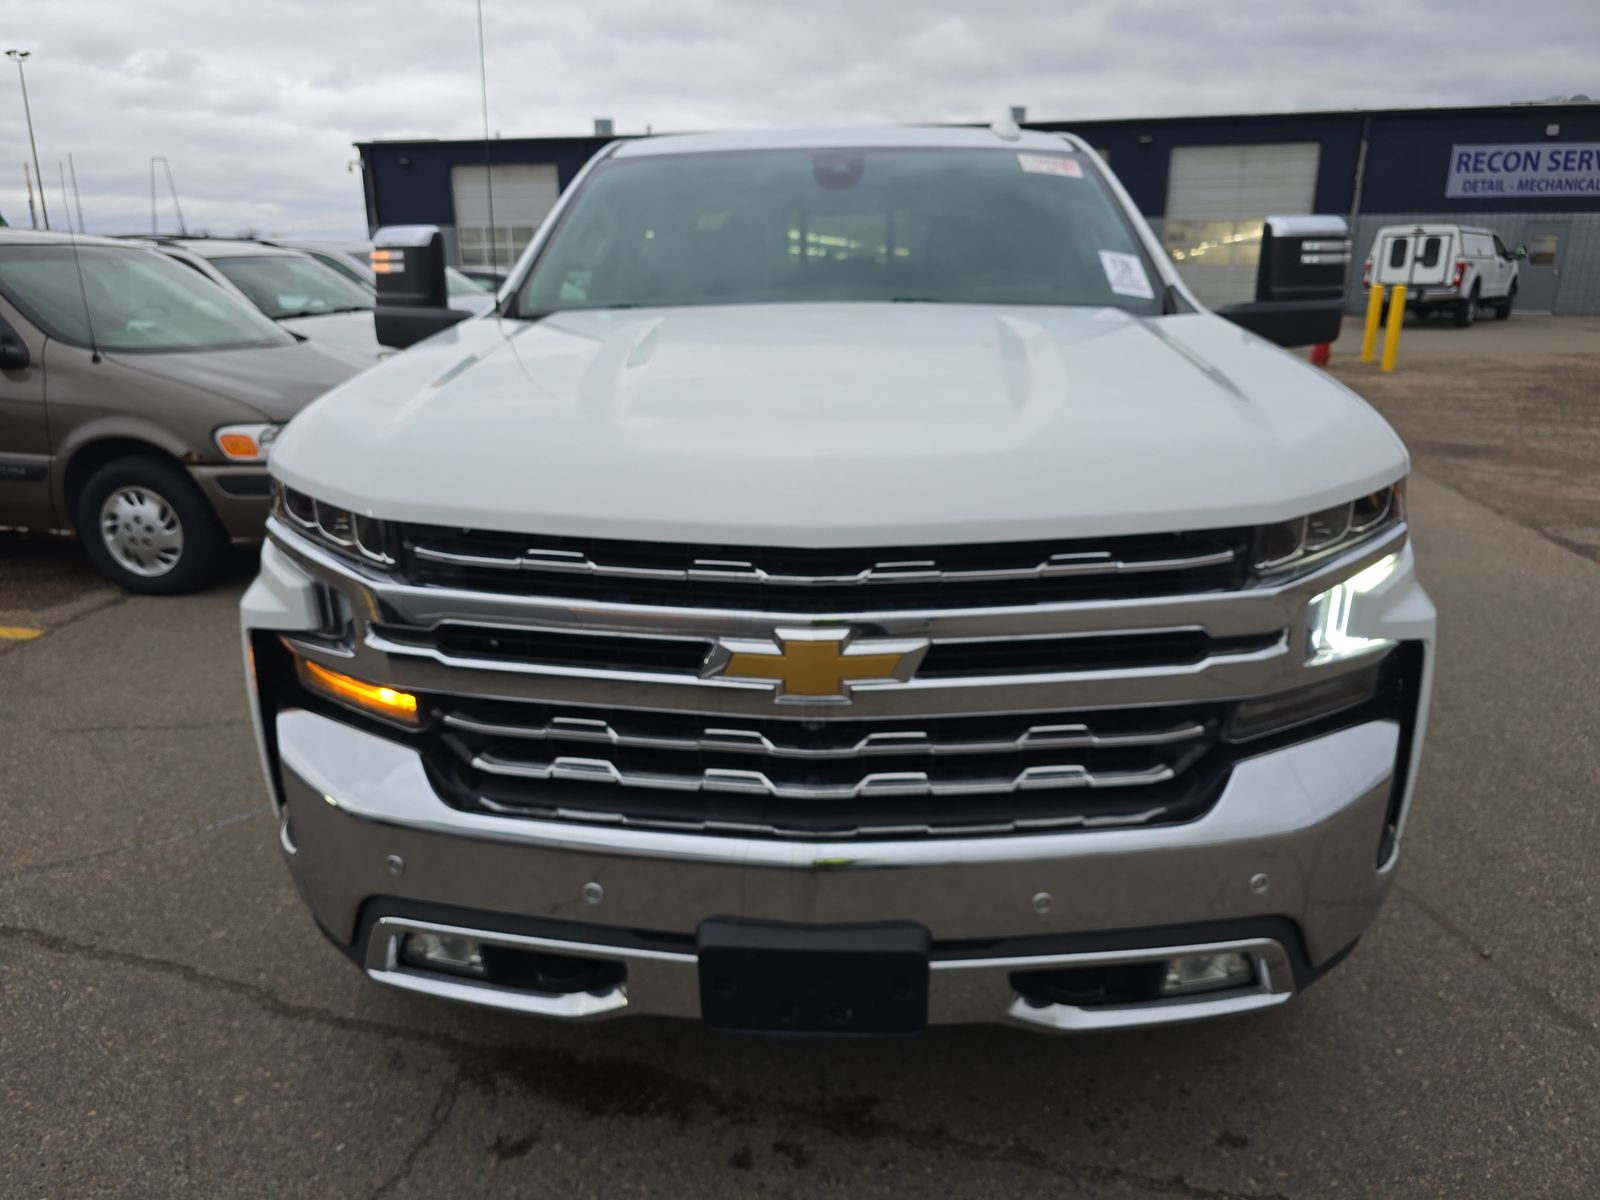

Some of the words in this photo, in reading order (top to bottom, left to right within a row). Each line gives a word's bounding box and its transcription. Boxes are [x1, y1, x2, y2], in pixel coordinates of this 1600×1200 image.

[1456, 150, 1541, 173] RECON
[1547, 149, 1600, 172] SER
[1462, 179, 1505, 193] DETAIL
